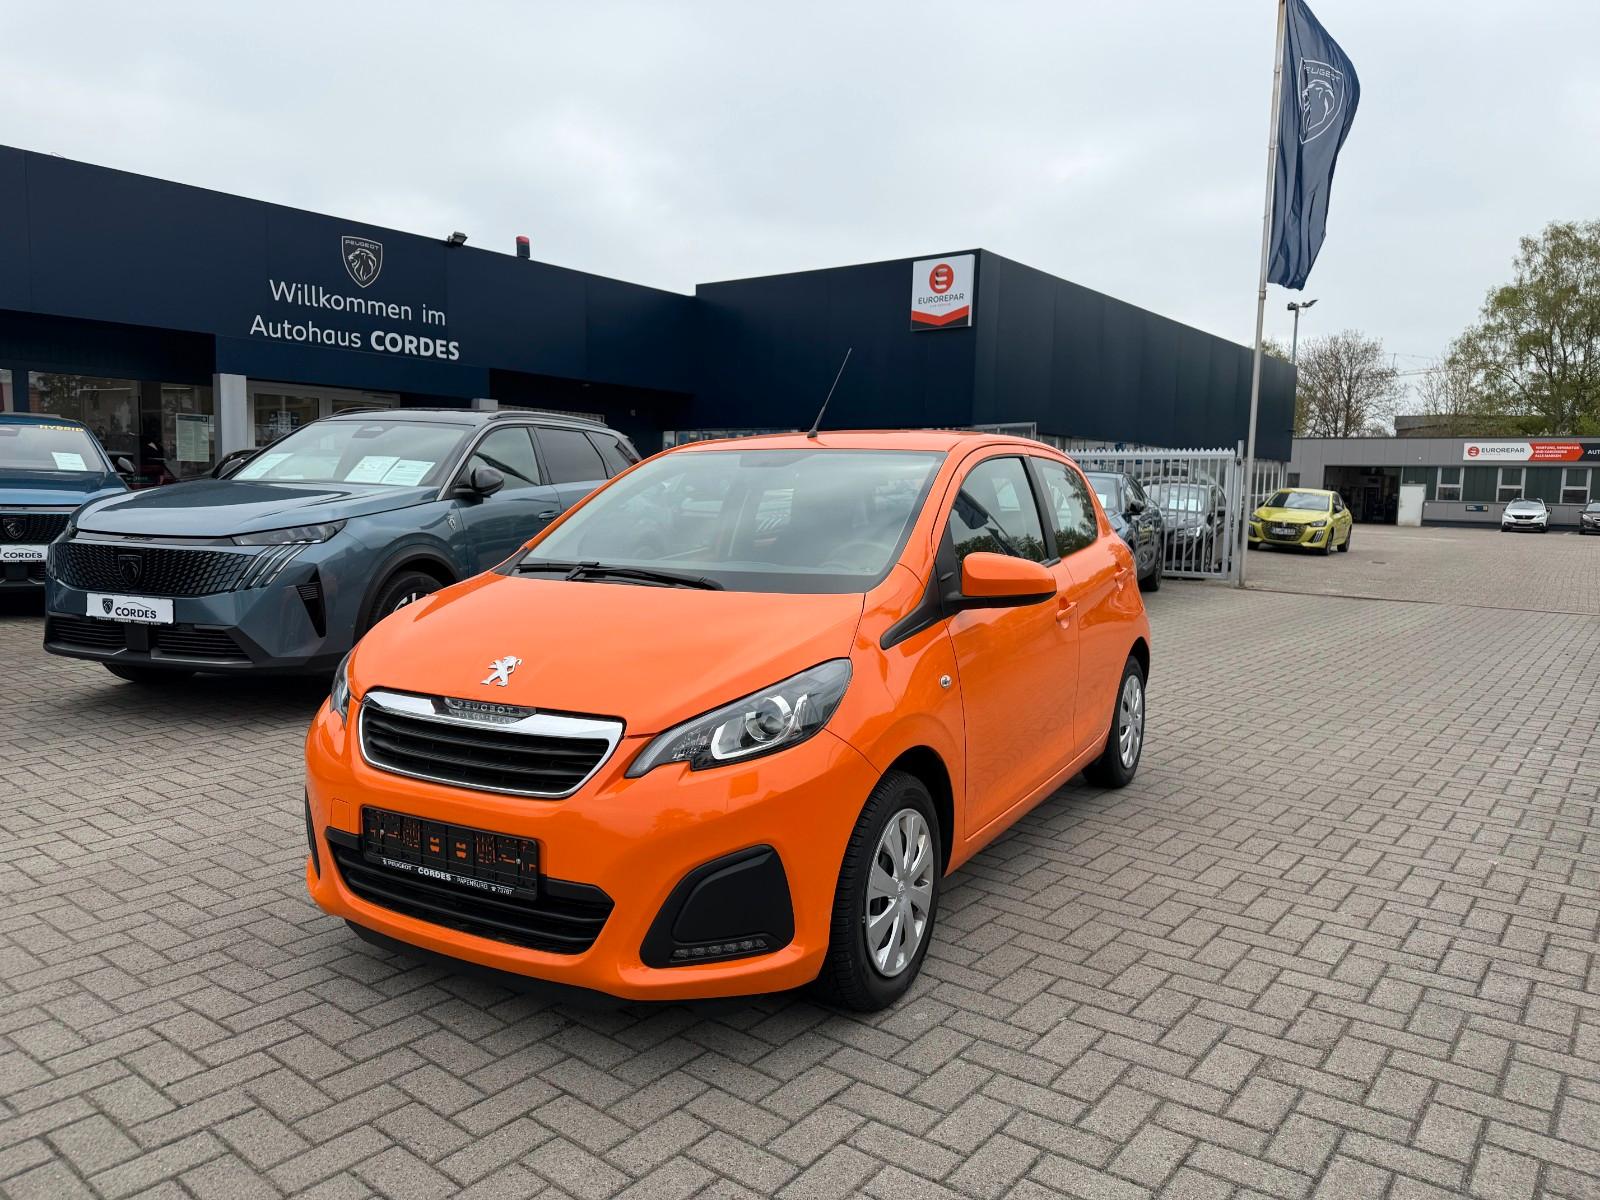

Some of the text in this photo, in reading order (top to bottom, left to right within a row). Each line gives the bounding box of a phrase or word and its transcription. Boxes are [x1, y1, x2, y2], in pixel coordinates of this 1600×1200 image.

[345, 239, 380, 250] PEUGEOT
[269, 279, 446, 326] Willkommen im
[918, 293, 964, 304] EUROREPAR
[249, 314, 460, 360] Autohaus CORDES
[115, 606, 157, 619] CORDES
[456, 700, 514, 714] PEUGEOT
[418, 866, 452, 882] CORDES
[456, 877, 488, 890] PAPENBURG
